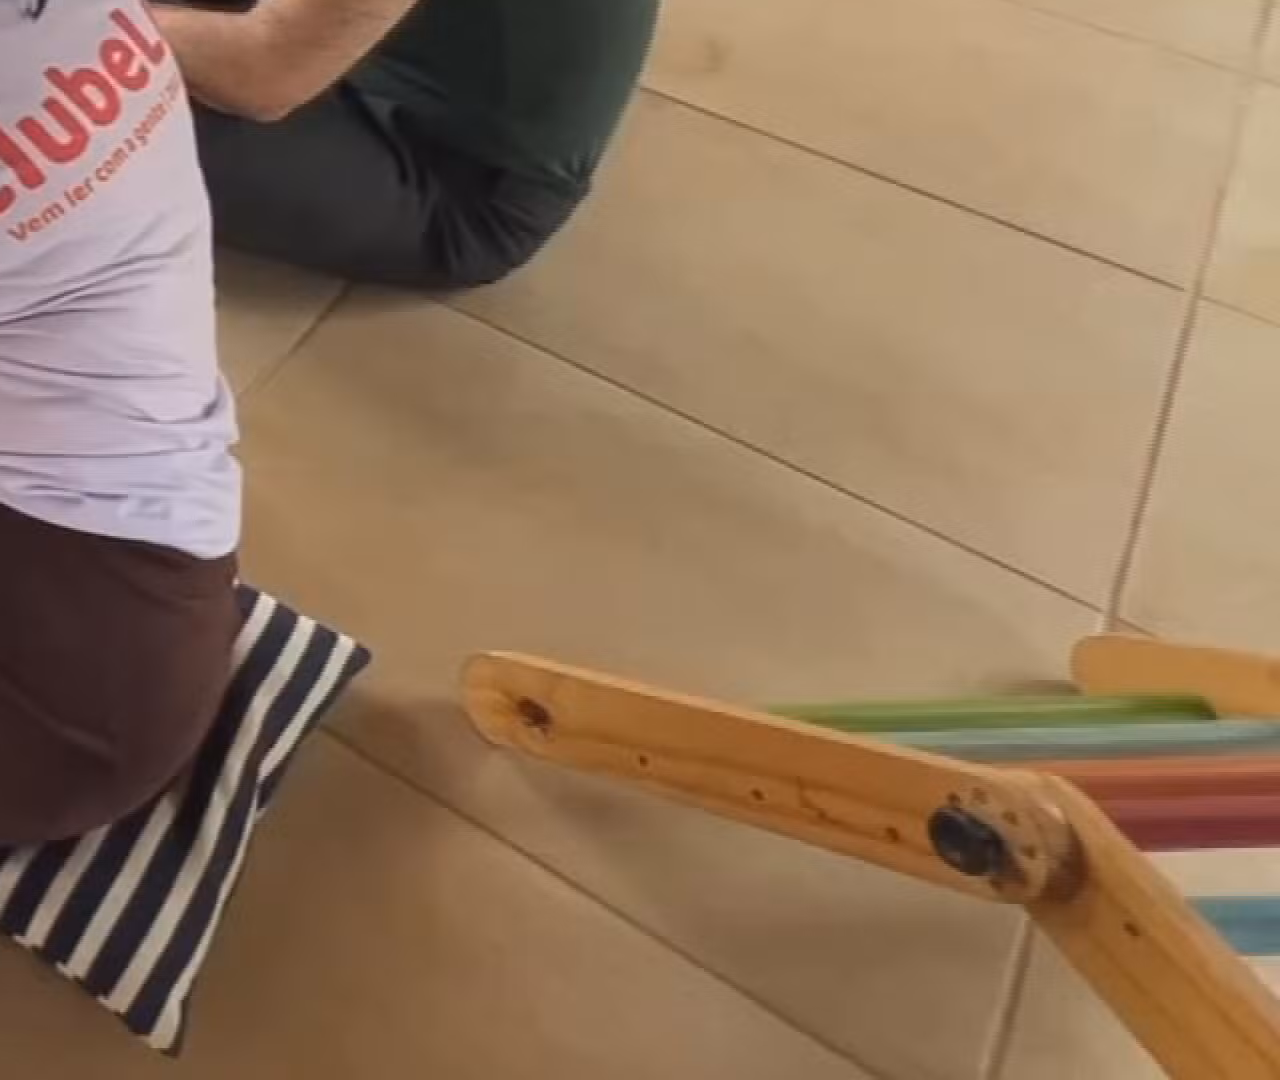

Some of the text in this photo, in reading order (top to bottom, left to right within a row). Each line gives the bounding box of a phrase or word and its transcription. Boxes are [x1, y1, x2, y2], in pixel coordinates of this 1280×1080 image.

[6, 202, 65, 241] Vem
[63, 177, 95, 207] ler
[95, 146, 130, 181] com
